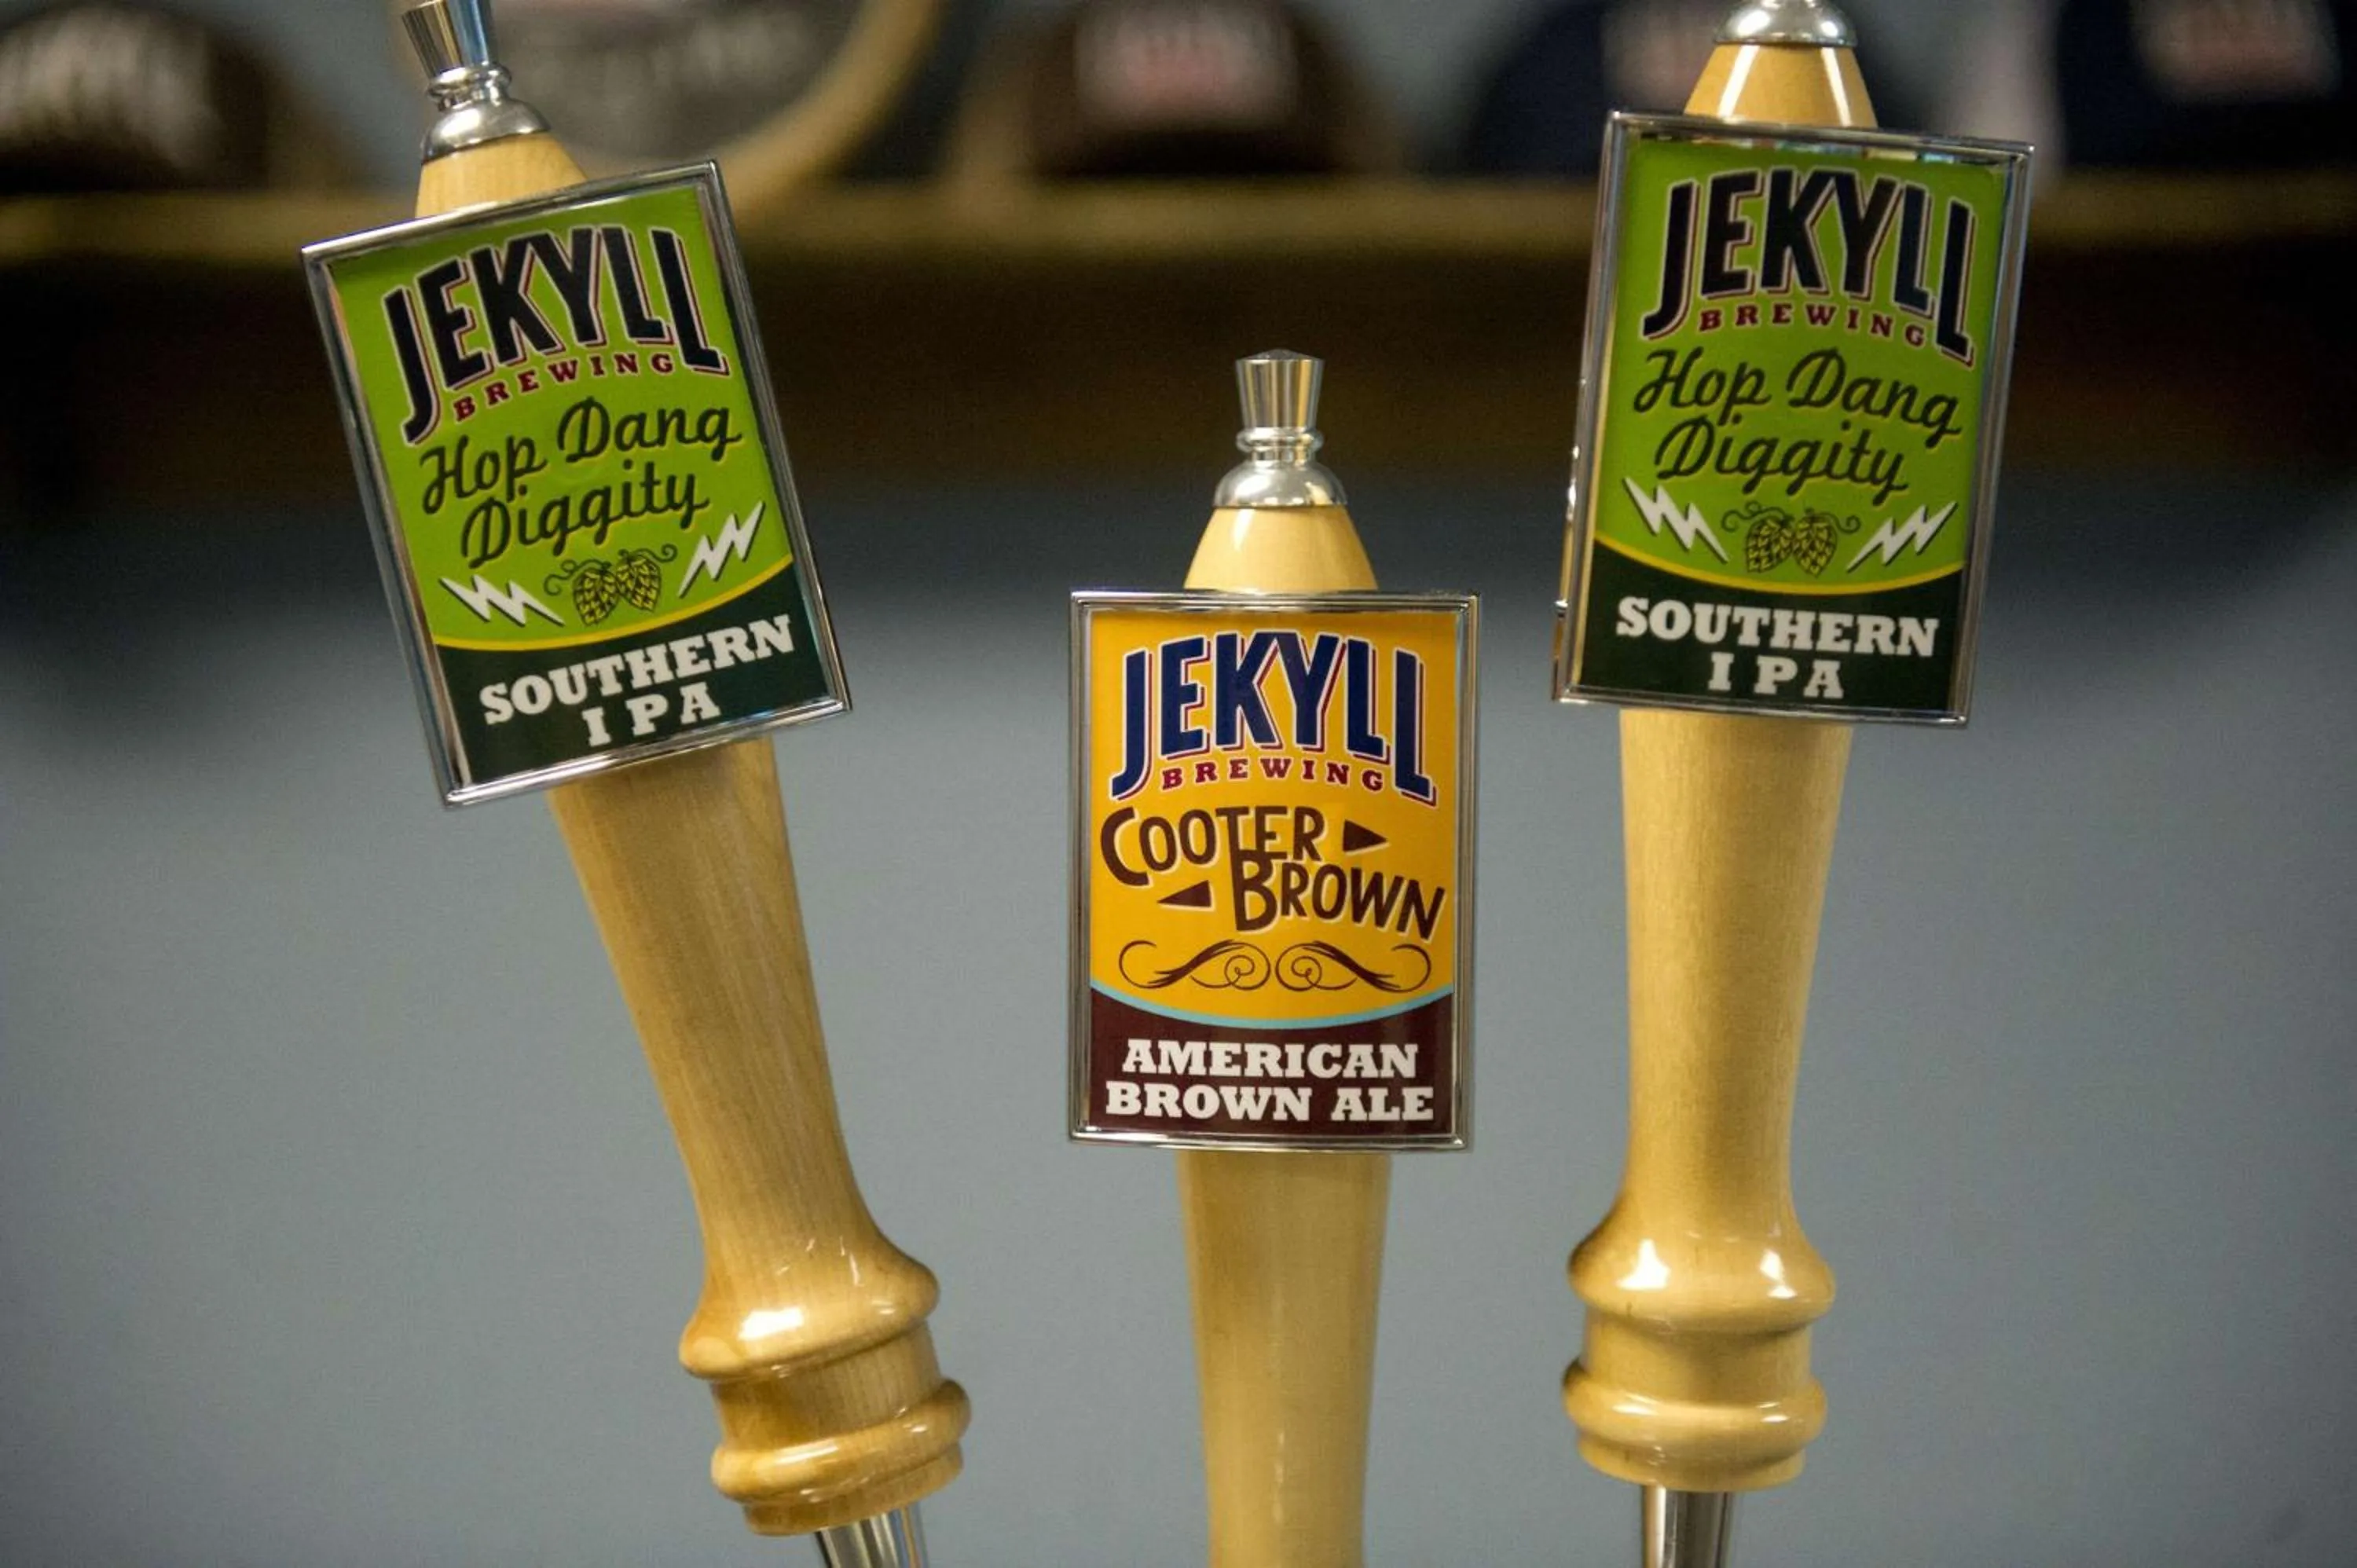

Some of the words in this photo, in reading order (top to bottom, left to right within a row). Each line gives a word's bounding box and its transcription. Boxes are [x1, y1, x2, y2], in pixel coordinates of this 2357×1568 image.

[1640, 167, 1976, 370] JEKYLL
[383, 225, 730, 446] JEKYLL
[1698, 302, 1926, 348] BREWING
[454, 353, 674, 423] BREWING
[1633, 346, 1771, 425] Hop
[1786, 348, 1963, 449] Dang
[420, 434, 548, 515] Hop
[556, 397, 743, 464] Dang
[1655, 413, 1911, 506] Diggity
[460, 462, 710, 569] Diggity
[480, 615, 795, 725] SOUTHERN
[1616, 595, 1940, 657] SOUTHERN
[1108, 629, 1437, 807] JEKYLL
[1162, 757, 1384, 791] BREWING
[1100, 805, 1326, 886] COOTER
[1228, 849, 1446, 941] BROWN
[1105, 1081, 1312, 1121] BROWN
[1331, 1087, 1434, 1122] ALE
[1122, 1039, 1418, 1078] AMERICAN
